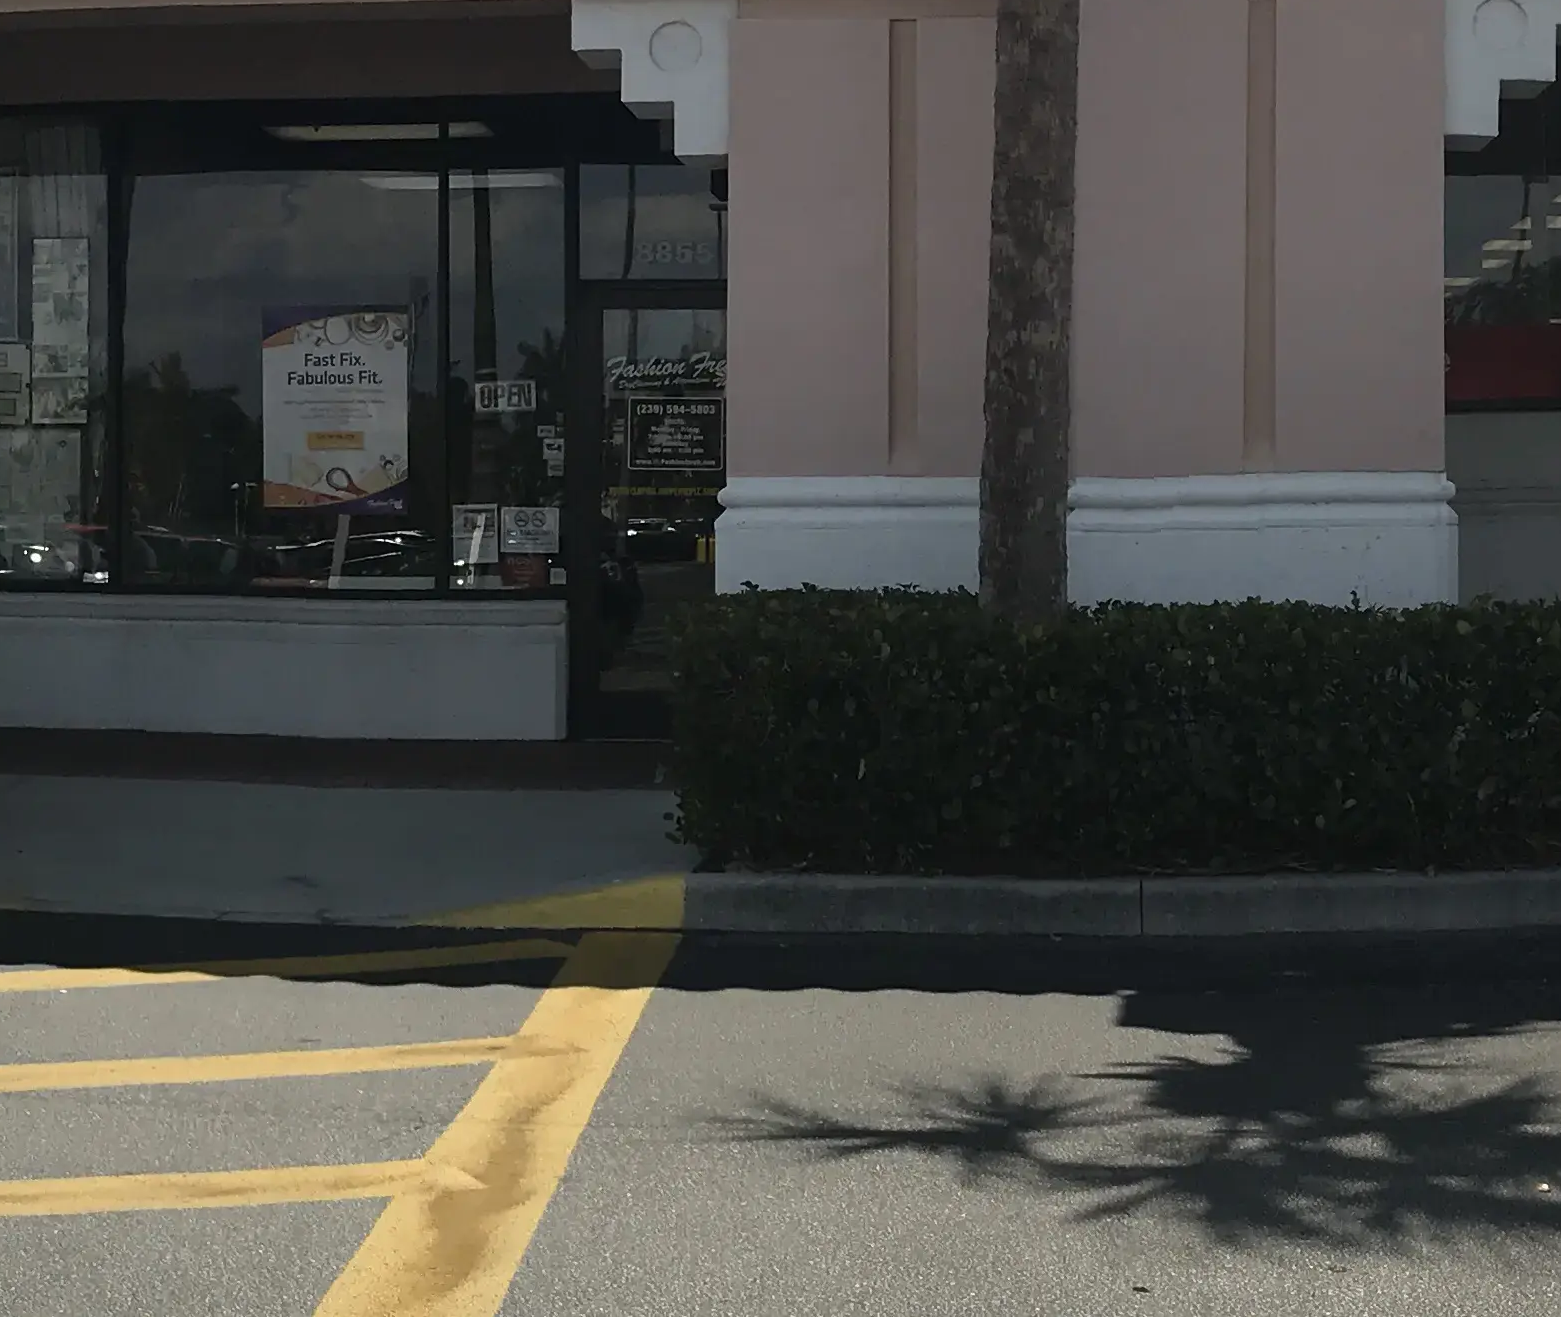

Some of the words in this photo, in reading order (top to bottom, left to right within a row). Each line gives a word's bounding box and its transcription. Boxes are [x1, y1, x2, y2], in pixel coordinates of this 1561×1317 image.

[635, 240, 715, 265] 8855
[304, 353, 335, 367] Fast
[340, 352, 366, 367] Fix.
[607, 355, 687, 382] Fashion
[689, 350, 727, 379] Fre
[287, 371, 354, 385] Fabulous
[358, 370, 383, 385] Fit.
[480, 383, 532, 409] OPEN
[636, 403, 663, 416] (239)
